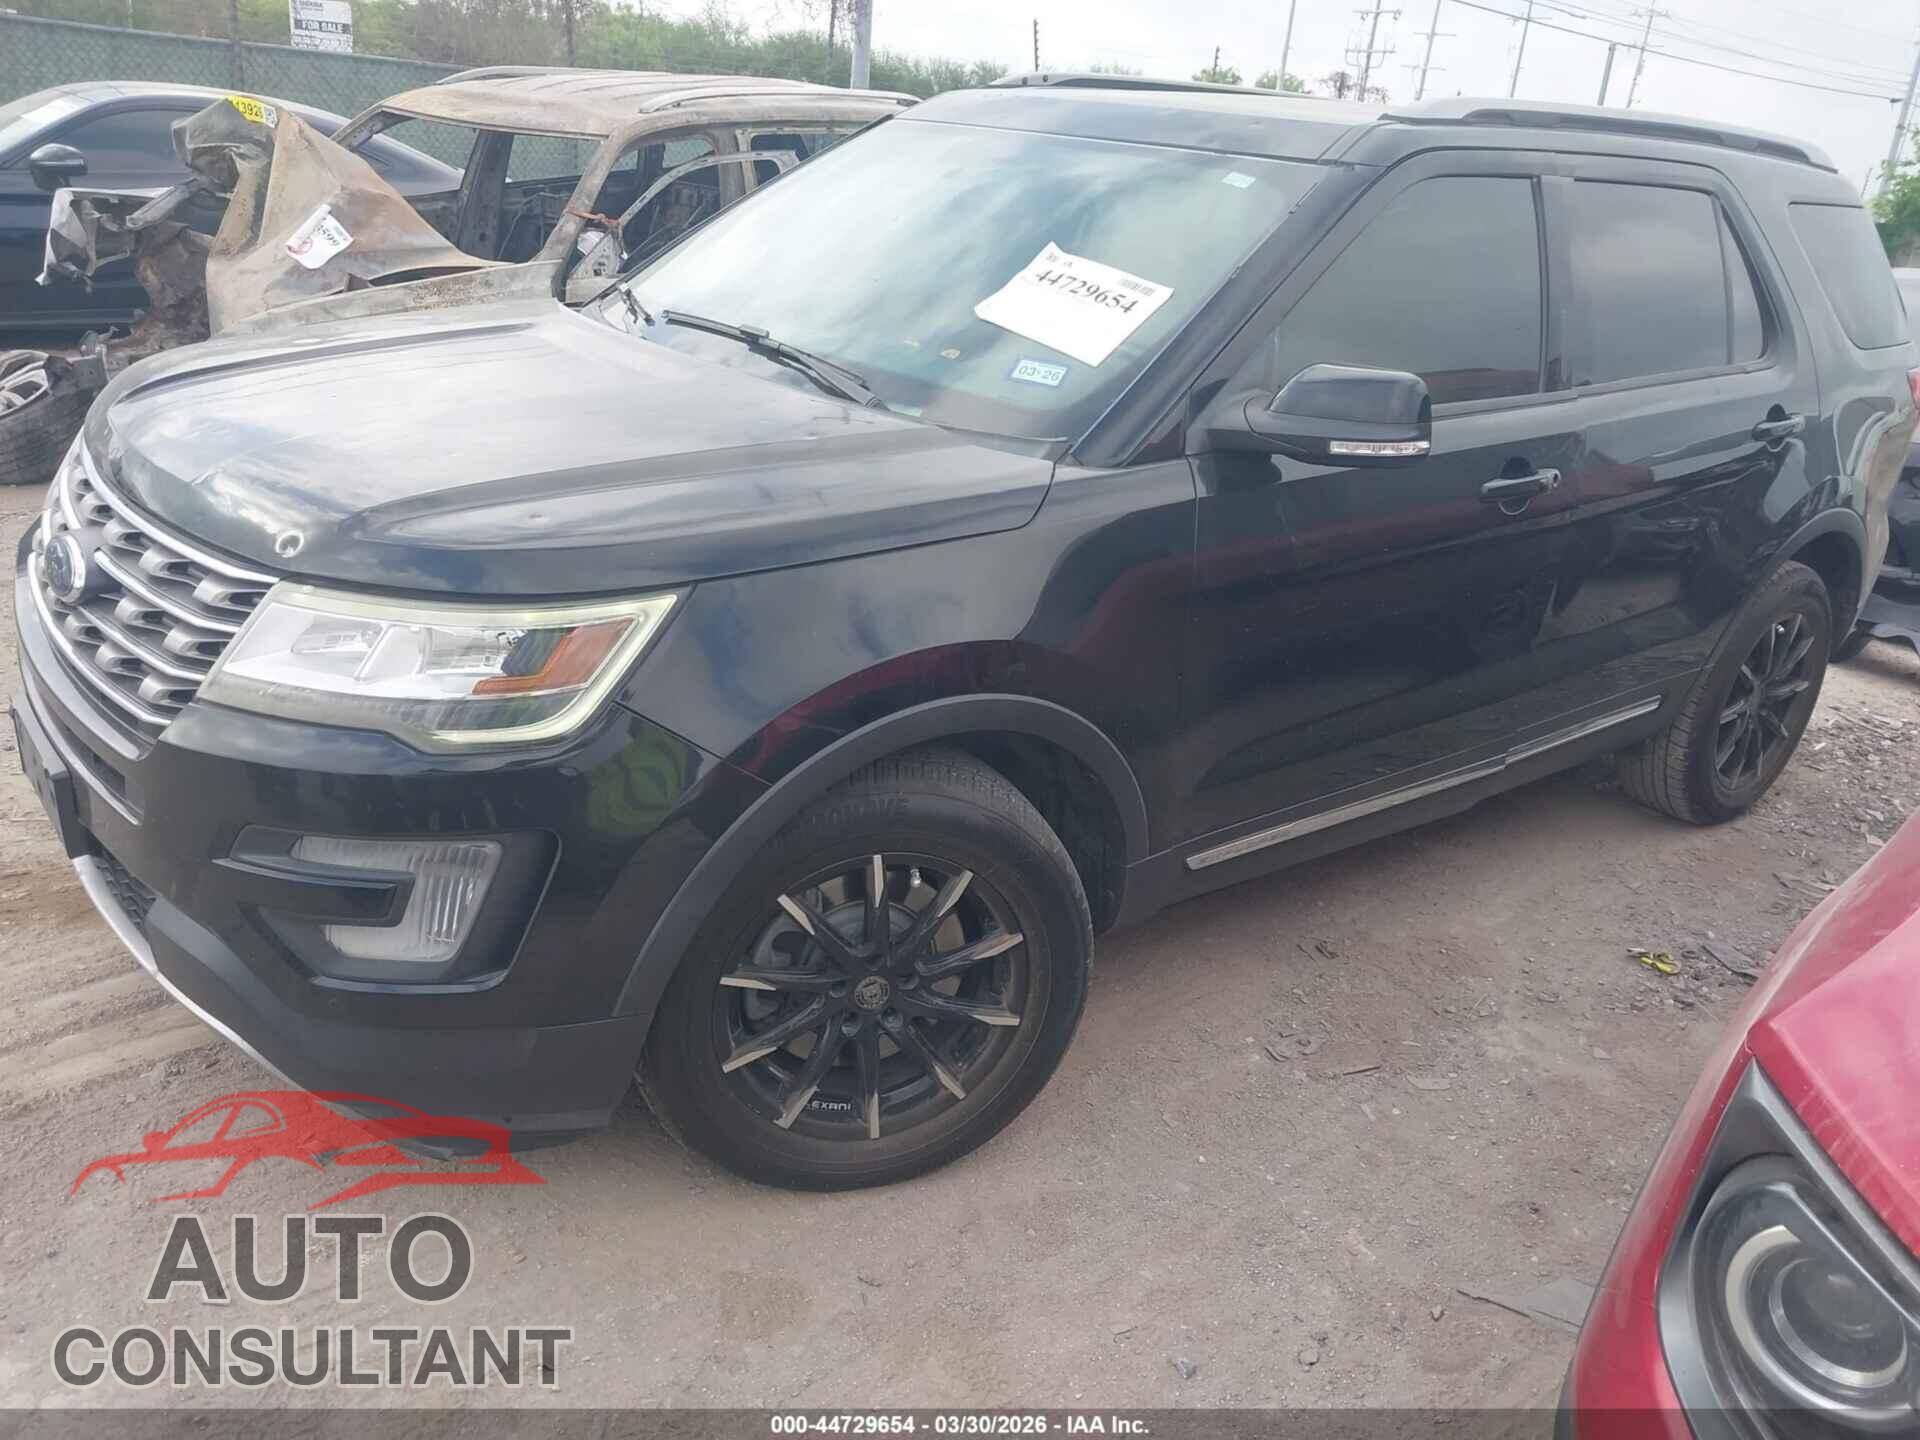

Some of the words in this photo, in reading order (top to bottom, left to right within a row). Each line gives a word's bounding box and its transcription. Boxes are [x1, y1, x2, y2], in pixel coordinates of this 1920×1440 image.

[302, 20, 320, 31] FOR
[321, 22, 343, 33] SALE
[1035, 269, 1139, 314] 44729654
